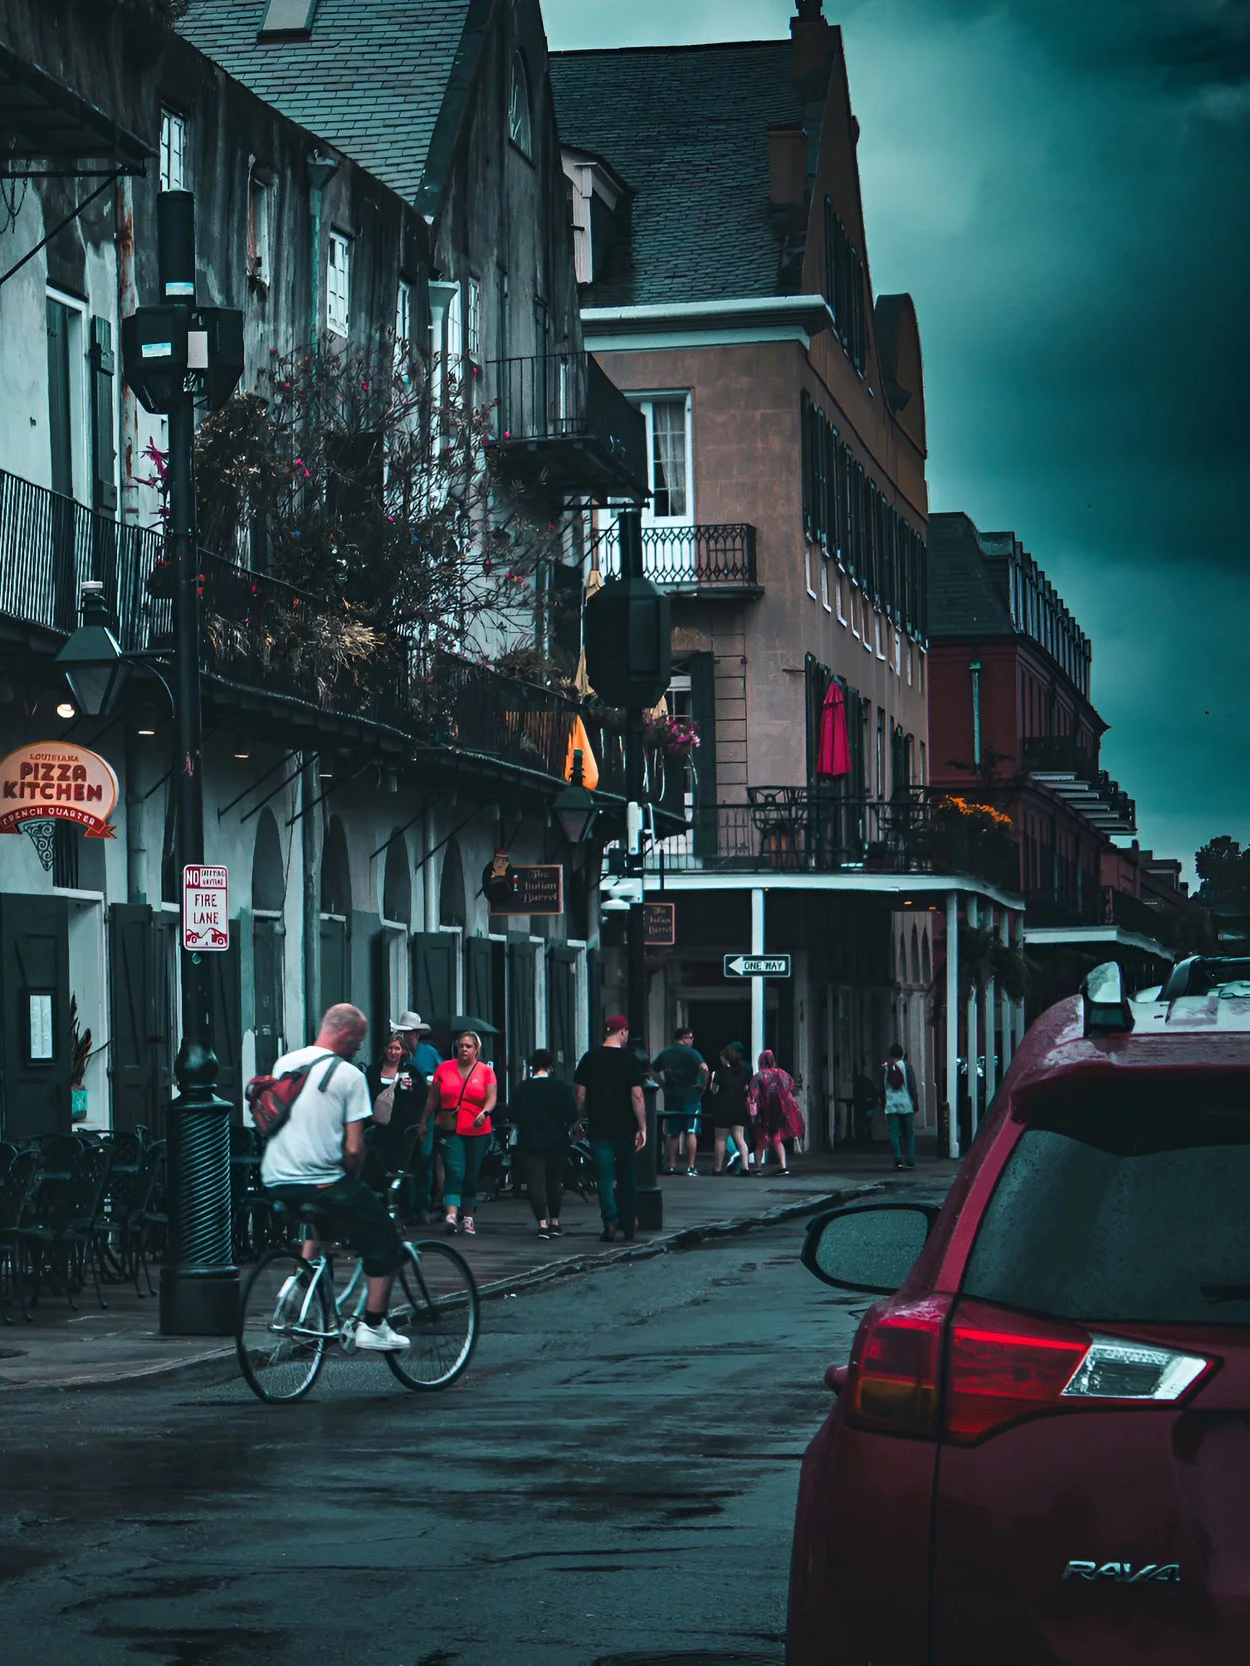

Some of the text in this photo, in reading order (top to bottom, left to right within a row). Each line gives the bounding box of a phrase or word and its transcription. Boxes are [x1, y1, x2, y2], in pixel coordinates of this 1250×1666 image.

[20, 761, 87, 782] PIZZA
[3, 780, 103, 801] KITCHEN
[2, 807, 96, 826] FRENCH QUARTER
[186, 869, 199, 886] NO
[194, 893, 218, 908] FIRE
[193, 912, 219, 925] LANE
[744, 961, 783, 971] ONE WAY
[1062, 1560, 1181, 1583] RAV4
